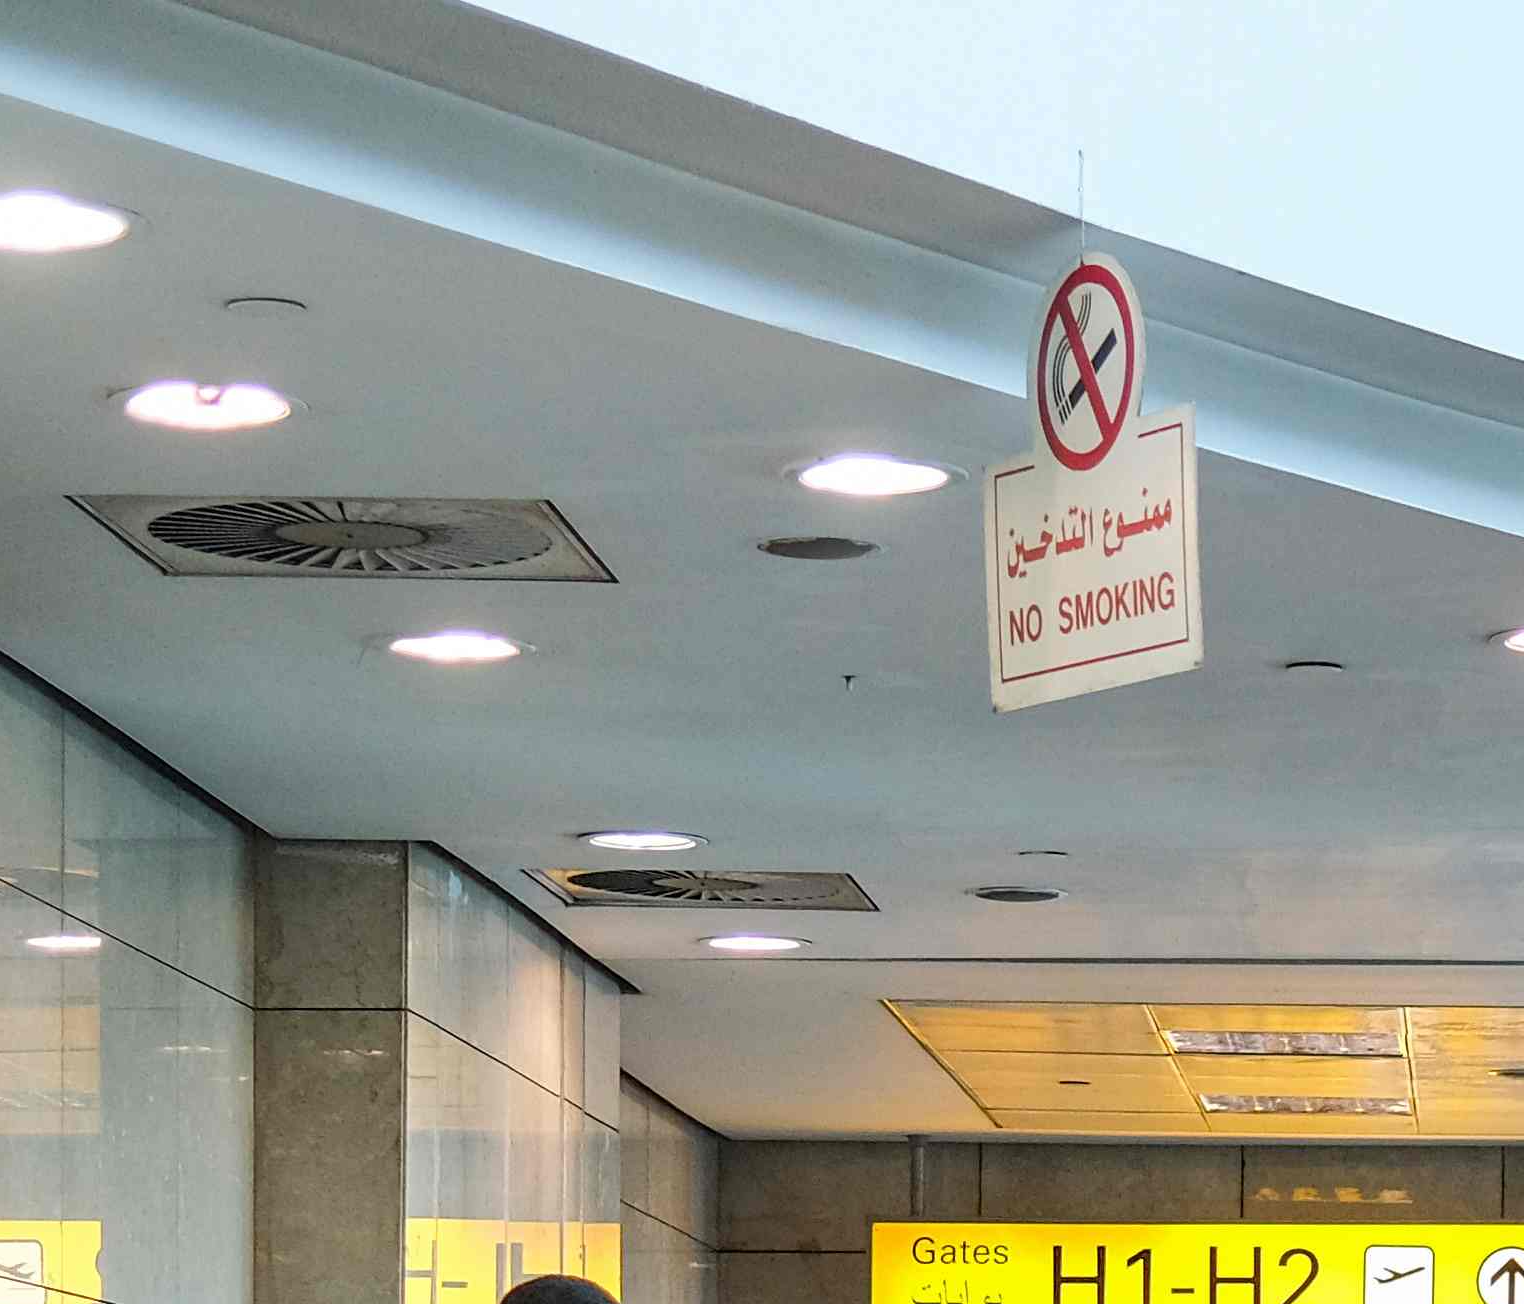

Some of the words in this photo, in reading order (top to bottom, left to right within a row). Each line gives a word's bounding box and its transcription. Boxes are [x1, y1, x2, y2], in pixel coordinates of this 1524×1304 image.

[1006, 505, 1094, 578] التدخين
[1103, 487, 1173, 558] ممنوع
[1008, 603, 1043, 646] NO
[1057, 571, 1176, 635] SMOKING
[911, 1236, 1009, 1265] Gates
